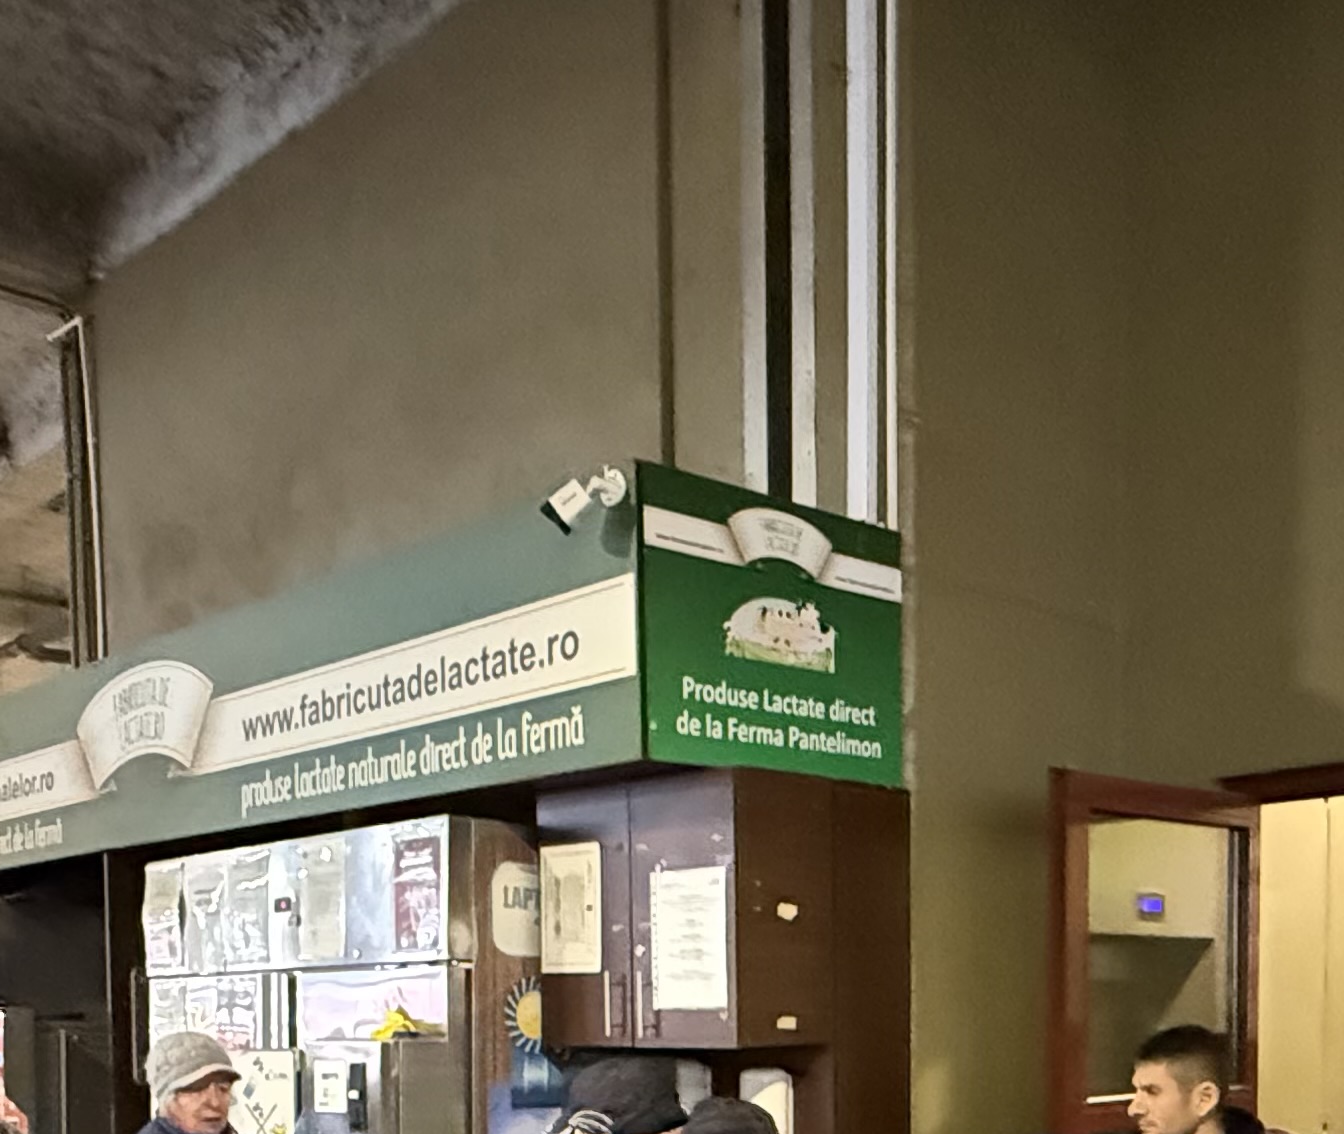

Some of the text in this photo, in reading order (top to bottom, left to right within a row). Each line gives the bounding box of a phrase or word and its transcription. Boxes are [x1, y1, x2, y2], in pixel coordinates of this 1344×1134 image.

[241, 629, 581, 743] www.fabricutadelactate.ro
[682, 675, 877, 727] Produse Lactate direct
[241, 705, 586, 819] produse lactate naturale direct de la fermă
[676, 709, 883, 759] de la Ferma Pantelimon
